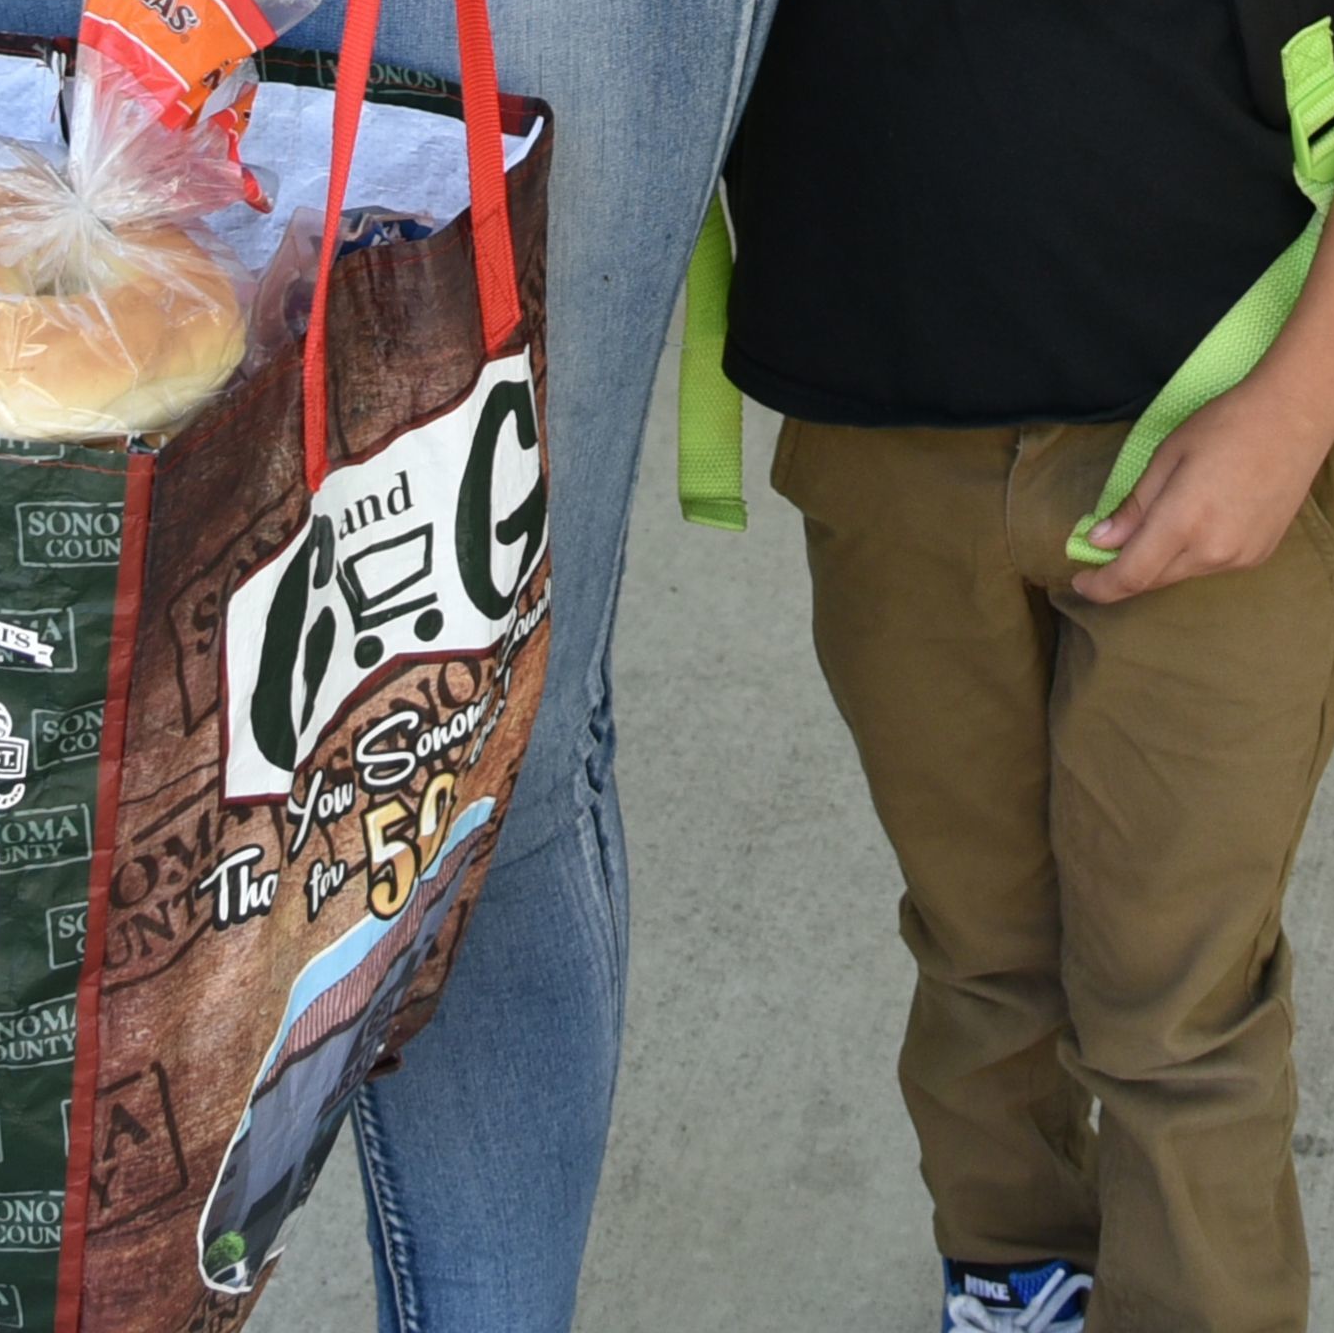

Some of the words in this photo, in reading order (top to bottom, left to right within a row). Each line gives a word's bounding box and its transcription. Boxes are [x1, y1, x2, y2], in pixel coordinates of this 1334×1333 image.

[338, 470, 416, 544] and
[455, 378, 547, 622] G
[27, 511, 125, 537] SONO
[45, 539, 123, 559] COUN
[287, 769, 354, 854] You
[964, 1273, 1011, 1302] NIKE
